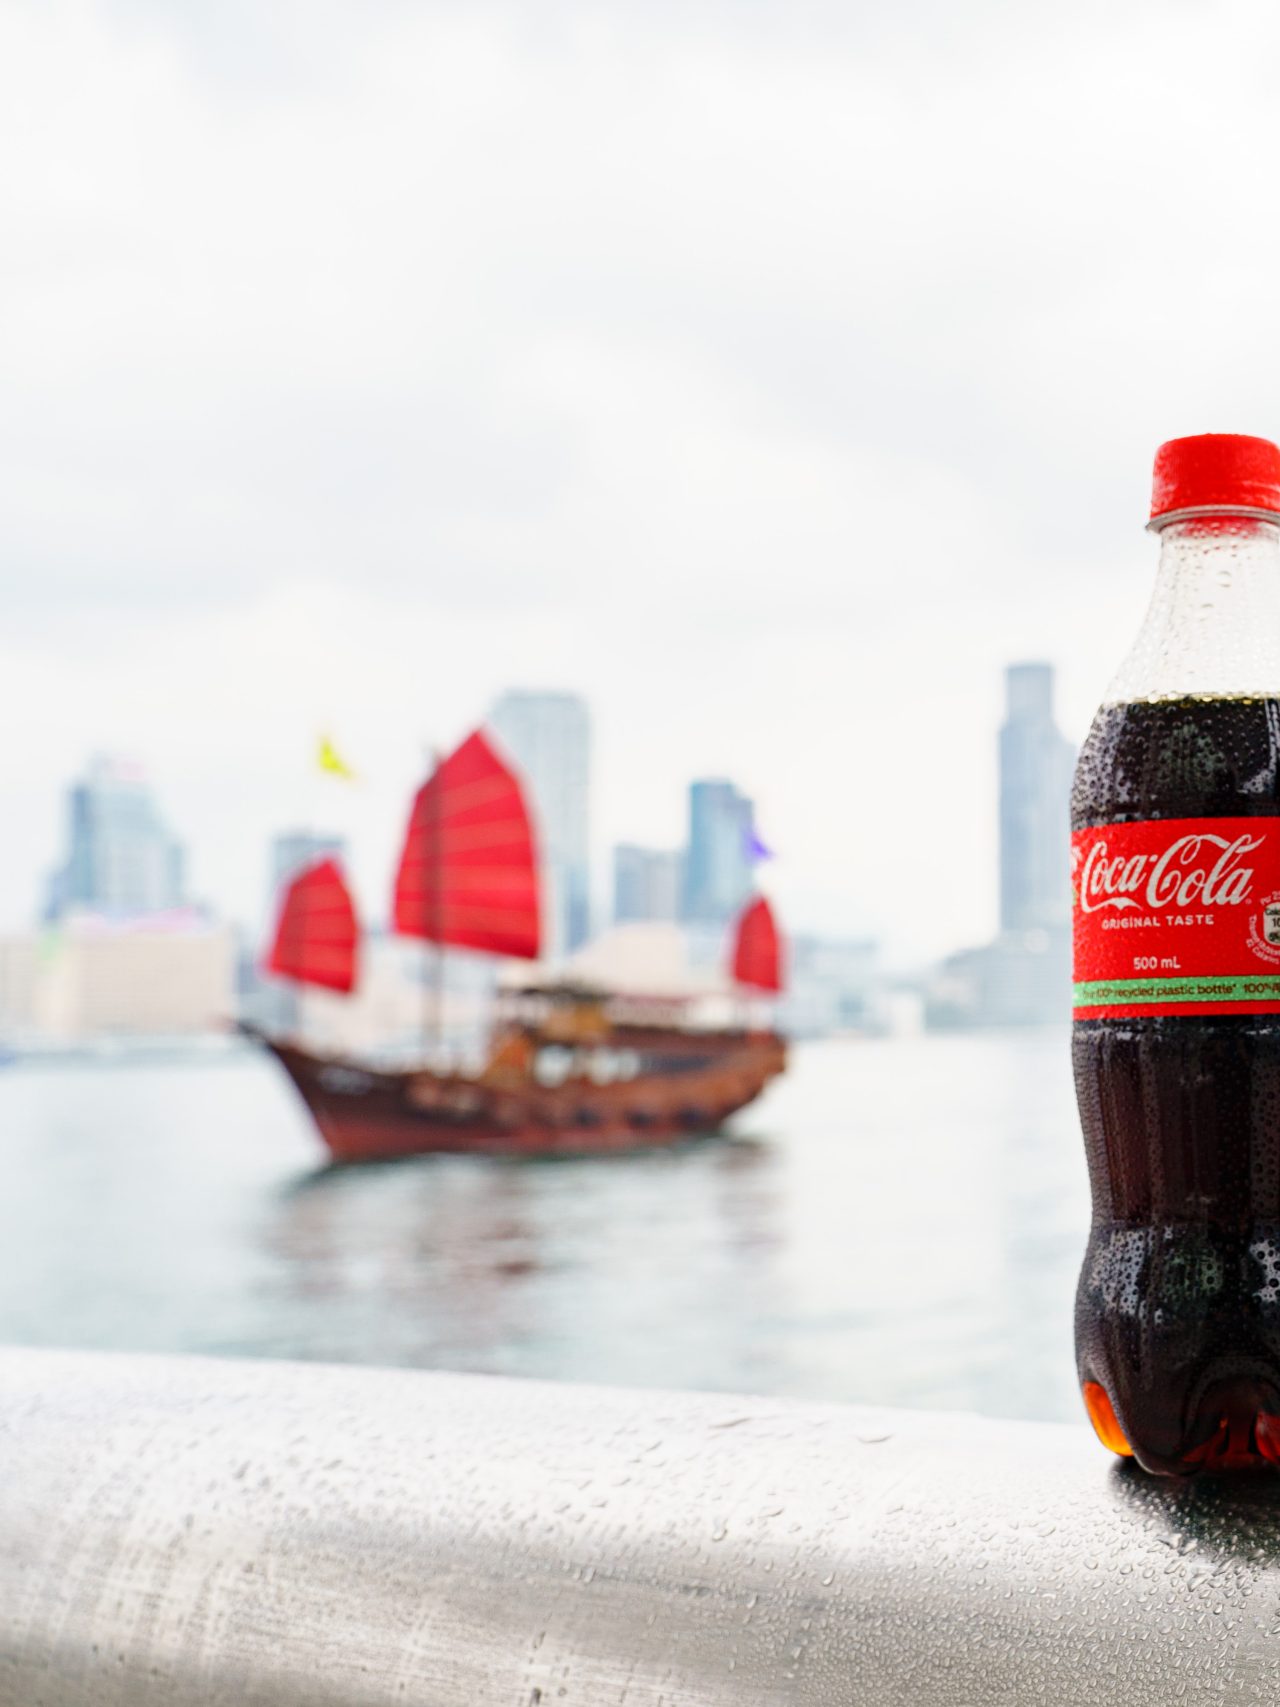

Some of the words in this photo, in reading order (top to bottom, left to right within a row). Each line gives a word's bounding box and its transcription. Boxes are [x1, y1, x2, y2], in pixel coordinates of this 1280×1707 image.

[1082, 834, 1267, 913] Coca-Cola
[1102, 916, 1161, 931] ORIGINAL
[1166, 914, 1214, 926] TASTE
[1133, 956, 1157, 970] 500
[1161, 956, 1181, 969] mL
[1114, 986, 1154, 998] recycled
[1157, 985, 1194, 997] plastic
